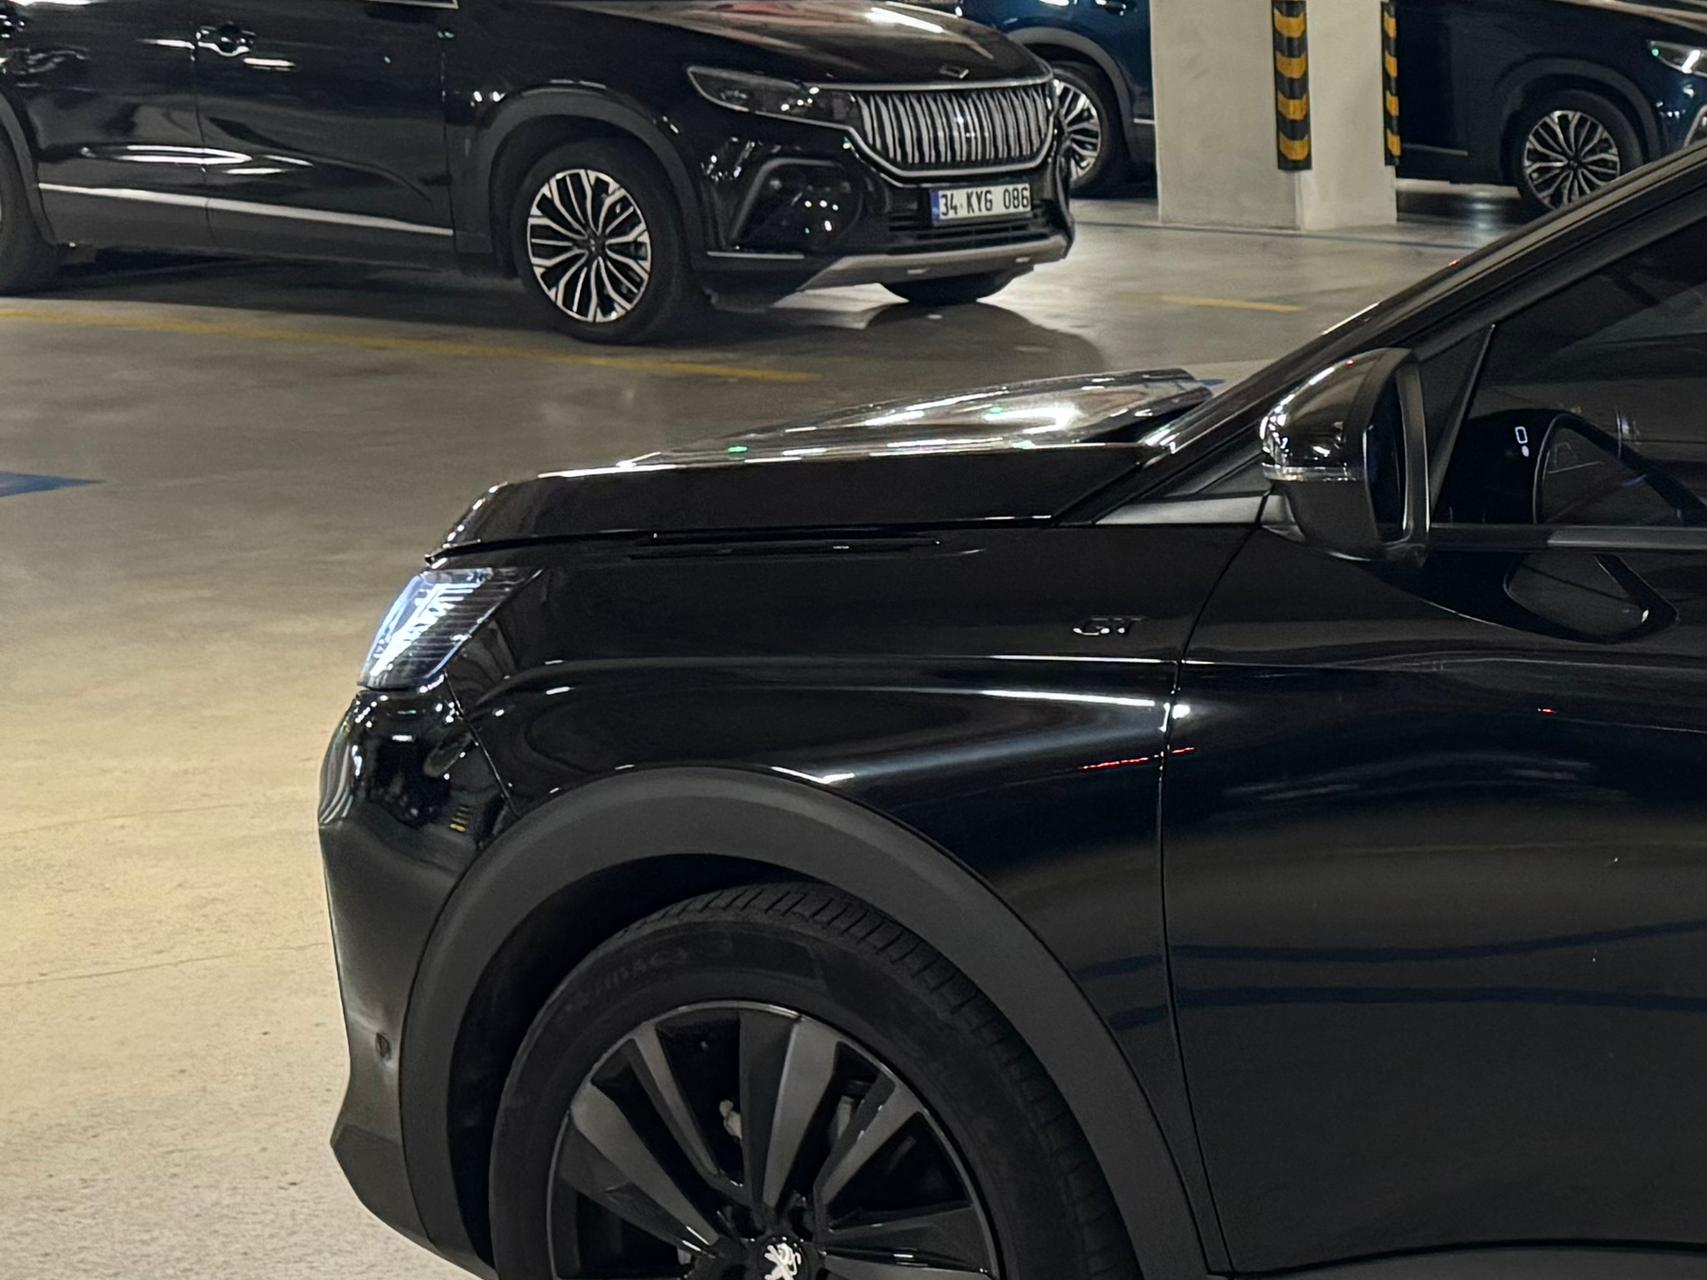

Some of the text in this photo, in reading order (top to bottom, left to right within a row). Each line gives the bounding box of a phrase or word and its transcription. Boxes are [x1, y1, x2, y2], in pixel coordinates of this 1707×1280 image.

[940, 187, 1030, 216] 34 KYG 086
